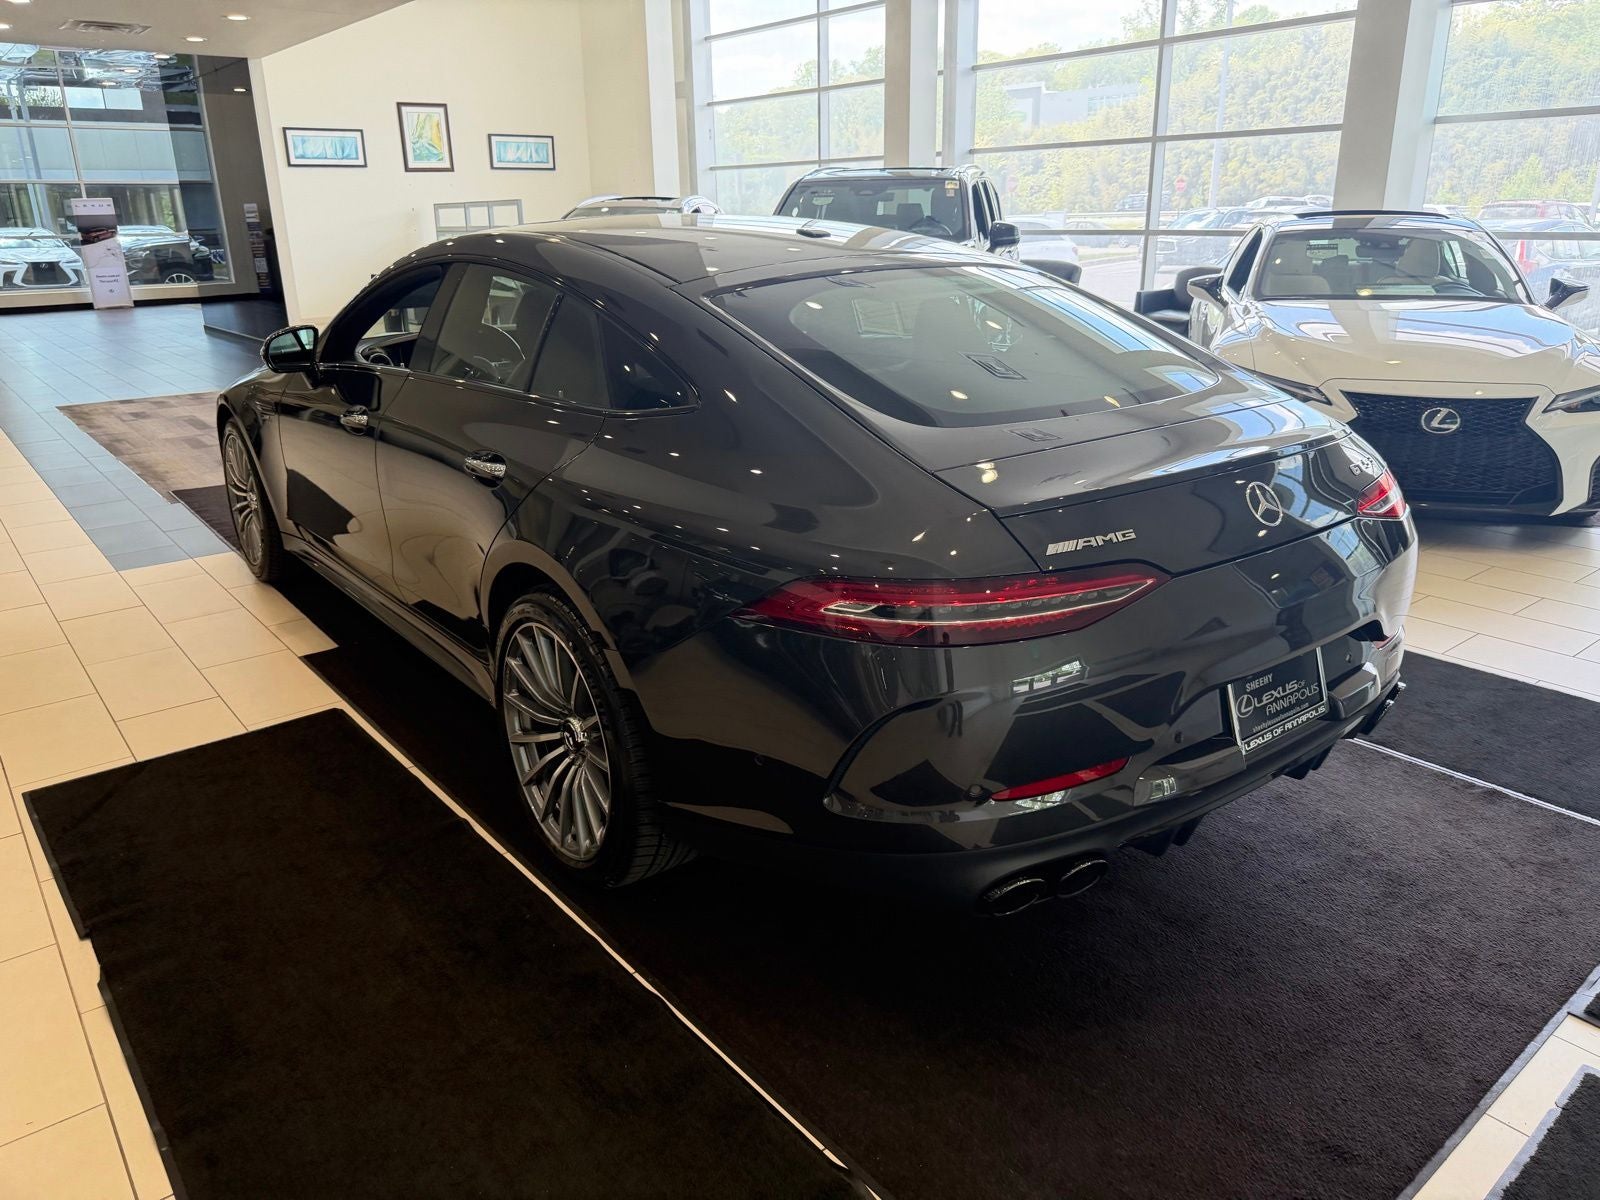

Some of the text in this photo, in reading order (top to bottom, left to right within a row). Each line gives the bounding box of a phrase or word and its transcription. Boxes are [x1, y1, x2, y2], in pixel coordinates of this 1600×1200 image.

[1076, 529, 1136, 550] AMG
[1245, 673, 1273, 692] SHEEHY
[1254, 680, 1297, 707] LEXUS
[1266, 682, 1319, 716] ANNAPOLIS
[1245, 705, 1326, 751] LEXUS OF ANNAPOLIS
